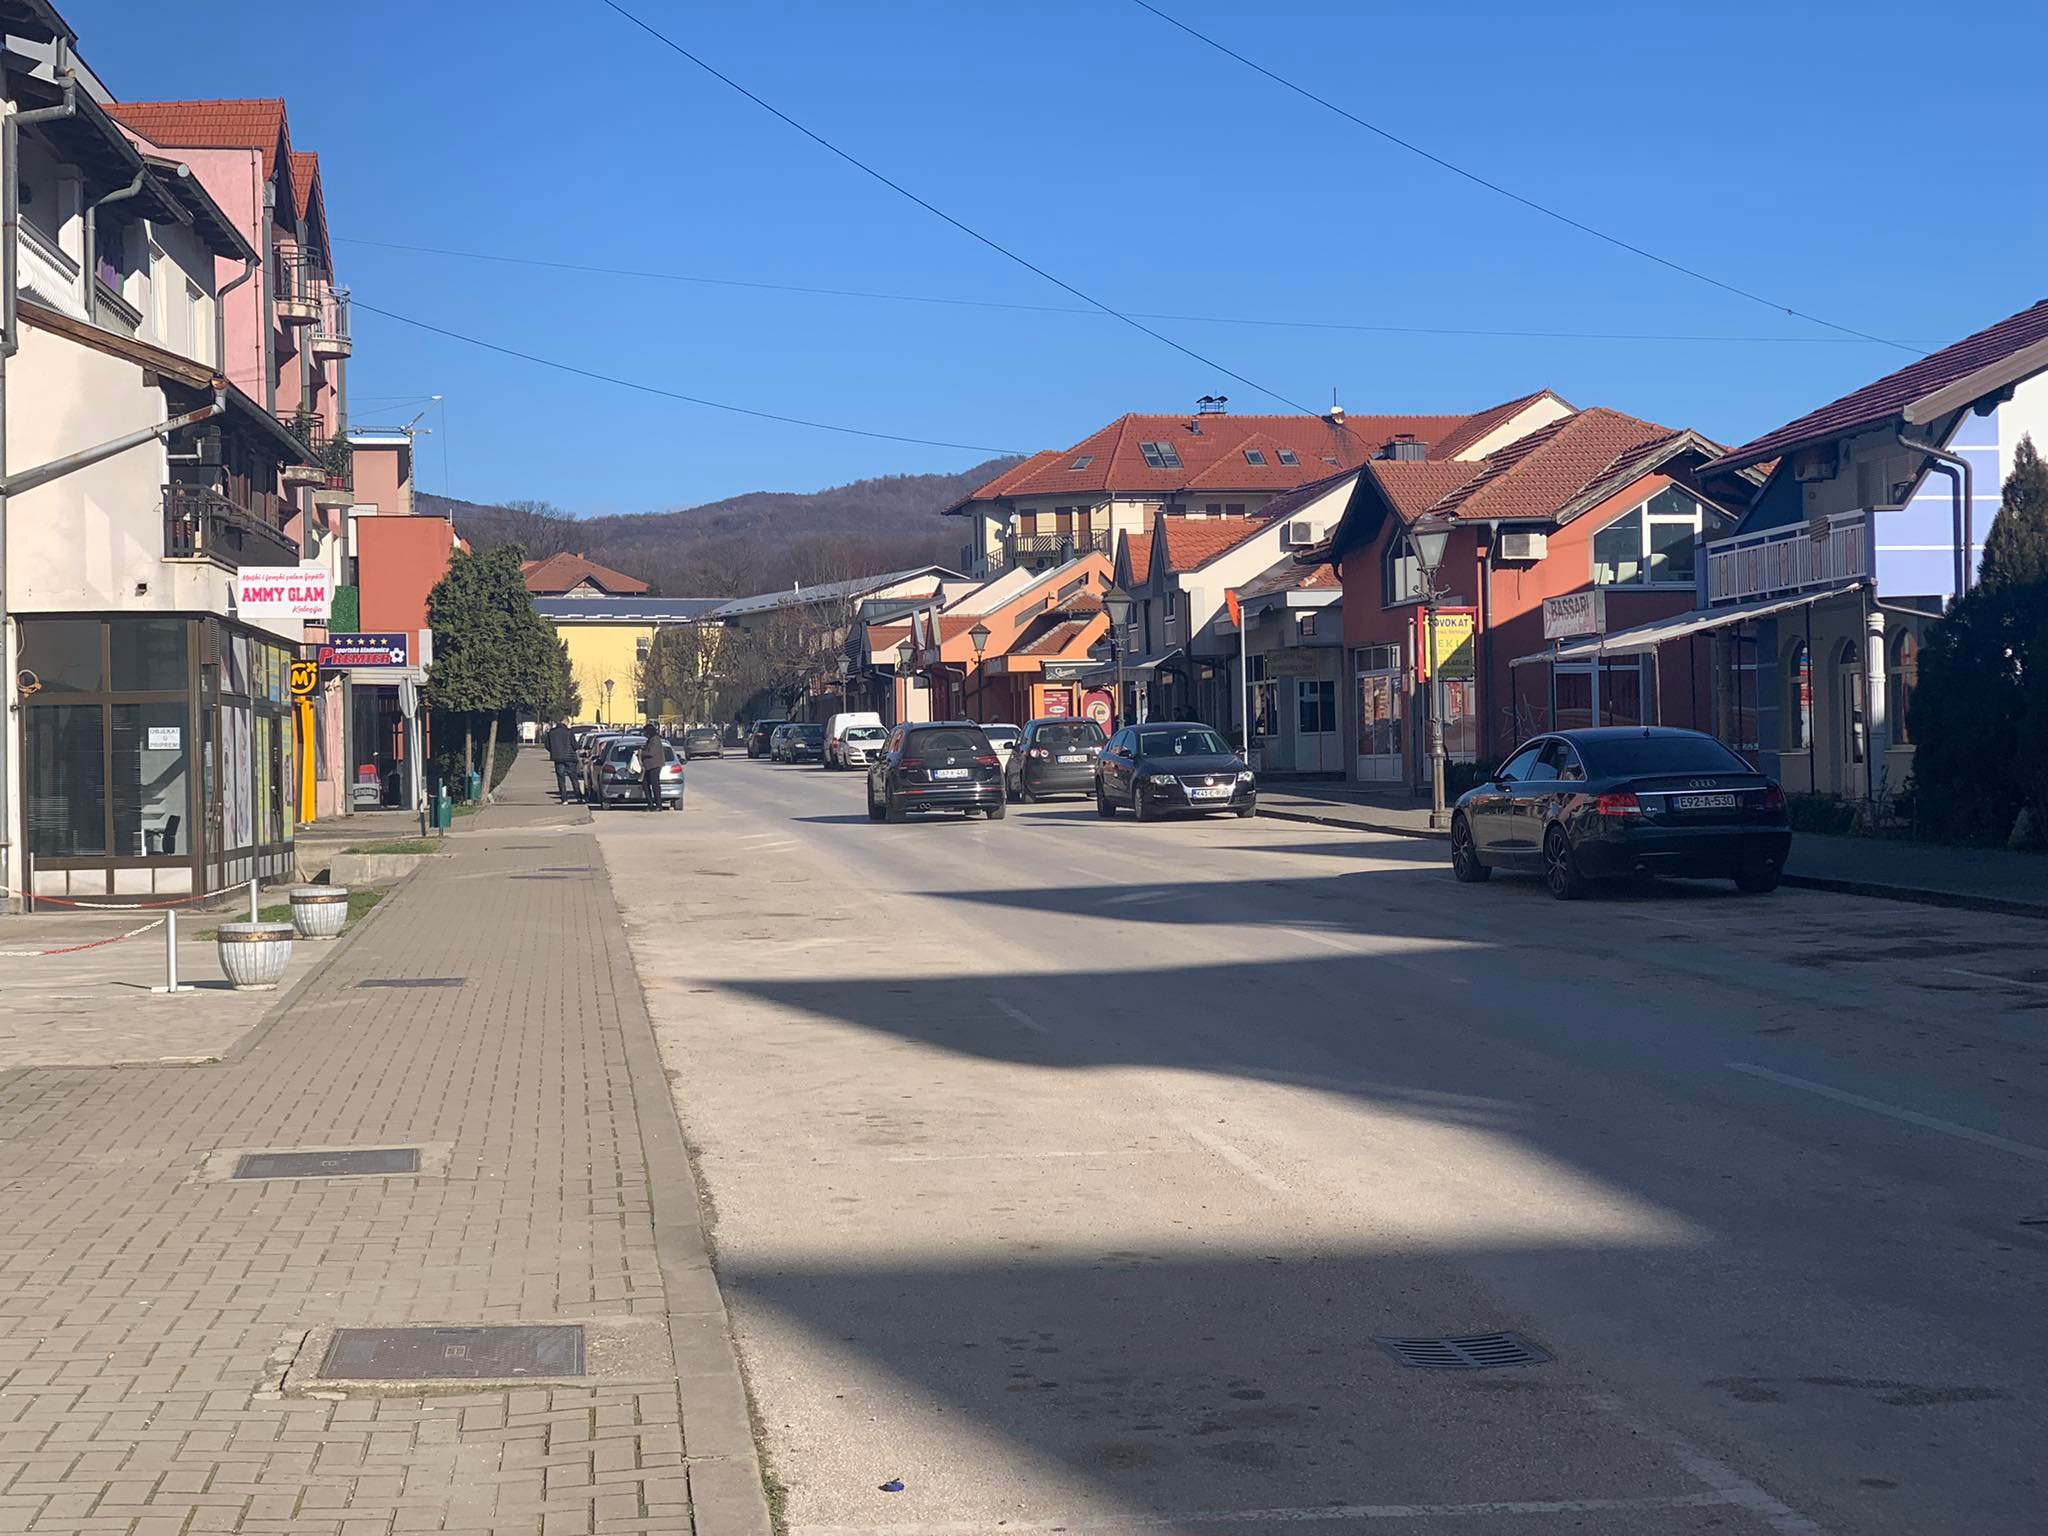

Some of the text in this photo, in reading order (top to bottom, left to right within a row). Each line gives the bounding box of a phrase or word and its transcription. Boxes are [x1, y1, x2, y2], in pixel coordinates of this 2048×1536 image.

[242, 587, 325, 602] AMMY GLAM
[319, 647, 391, 665] PREMIER
[1680, 795, 1735, 808] E92-A-530
